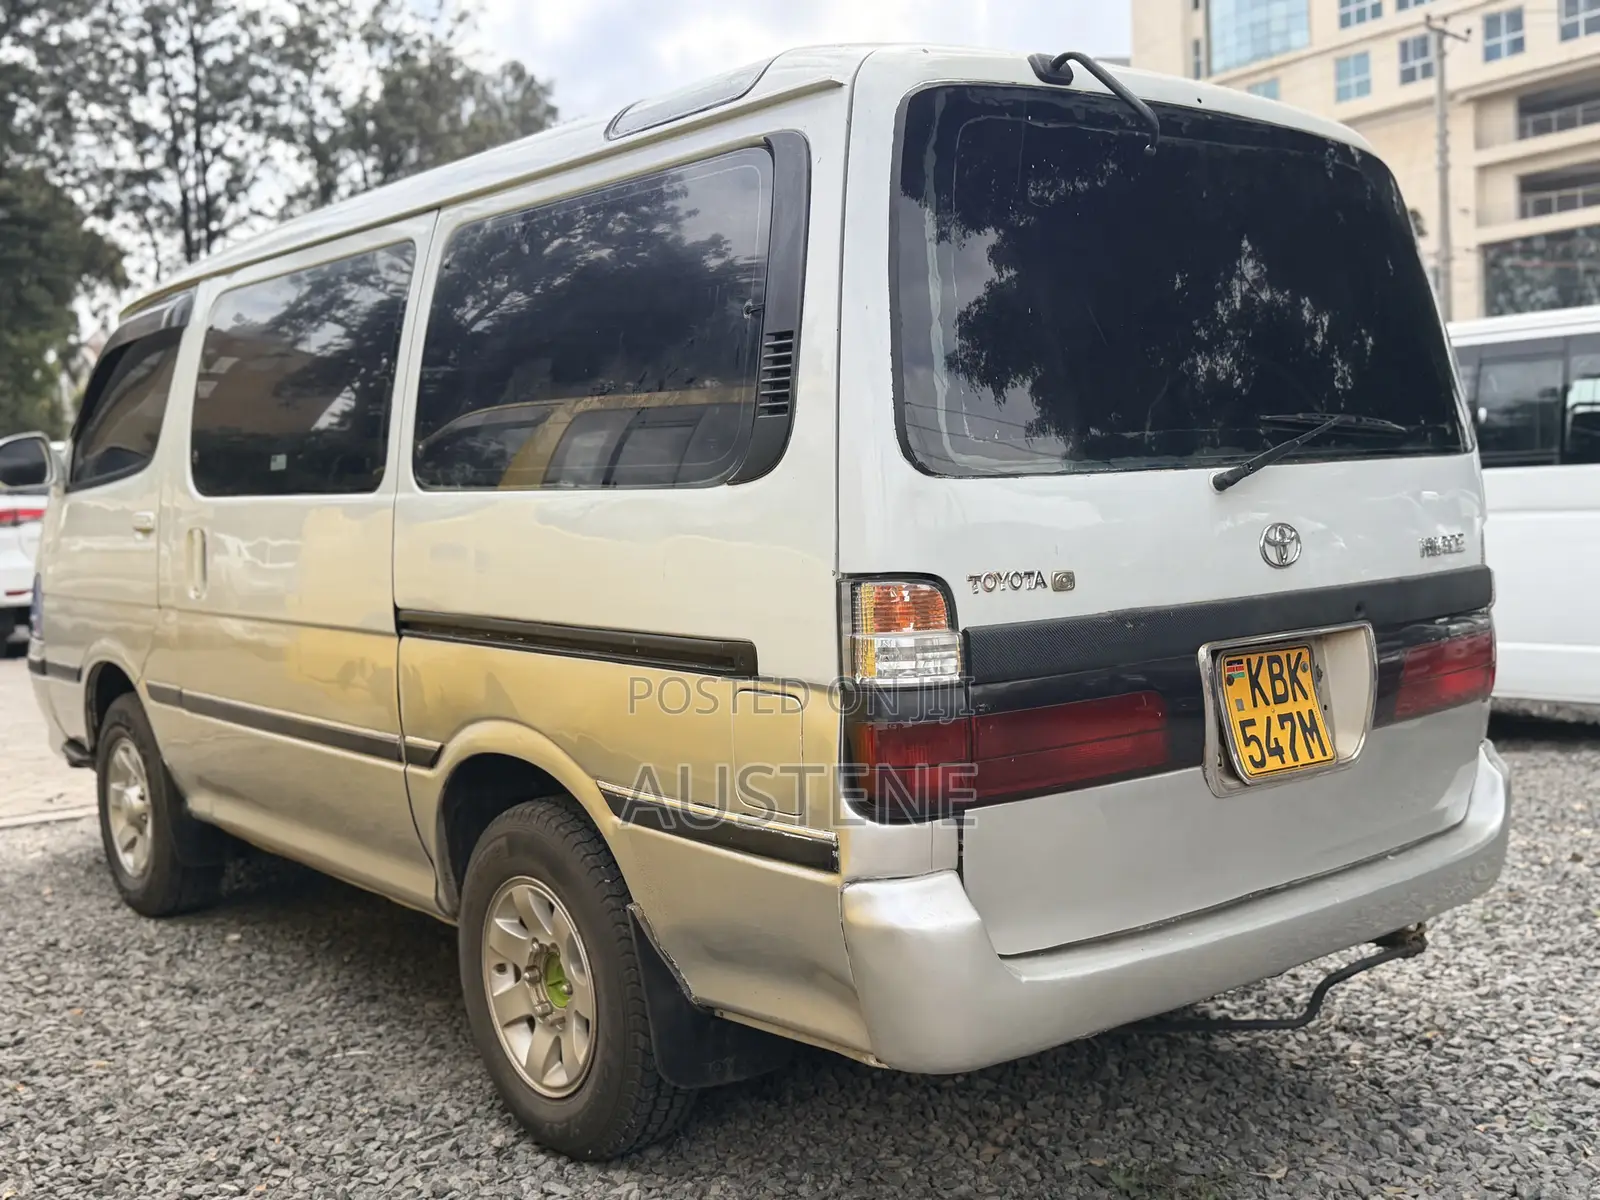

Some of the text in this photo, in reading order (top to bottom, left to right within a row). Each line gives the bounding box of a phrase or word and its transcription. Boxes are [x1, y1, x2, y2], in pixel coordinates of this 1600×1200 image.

[966, 570, 1048, 594] TOYOTA
[1246, 652, 1309, 708] KBK
[1239, 709, 1327, 769] 547M
